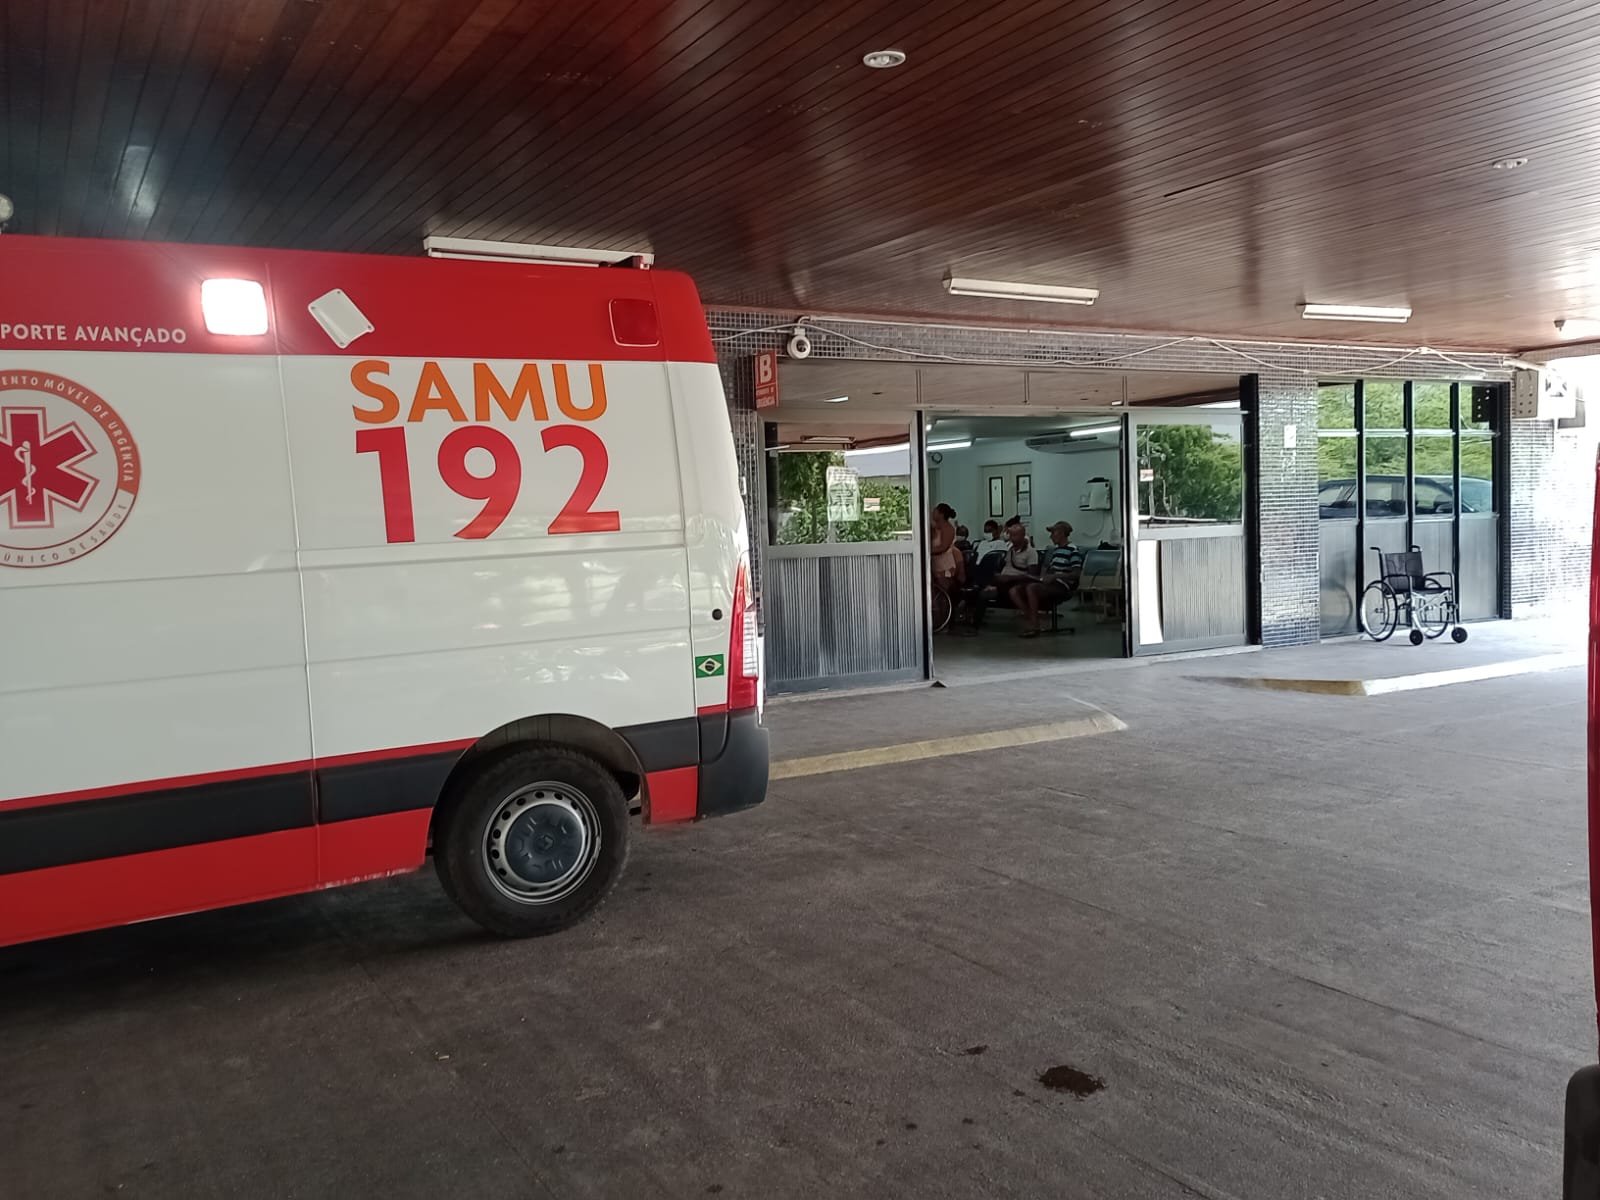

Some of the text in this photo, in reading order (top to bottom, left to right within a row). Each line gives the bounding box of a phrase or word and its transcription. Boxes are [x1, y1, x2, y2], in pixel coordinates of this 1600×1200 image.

[1, 323, 187, 347] PORTE AVANÇADO
[759, 354, 772, 384] B
[44, 379, 90, 404] MÓVEL
[92, 404, 109, 419] DE
[350, 359, 608, 424] SAMU
[355, 424, 621, 544] 192
[68, 543, 87, 555] DE
